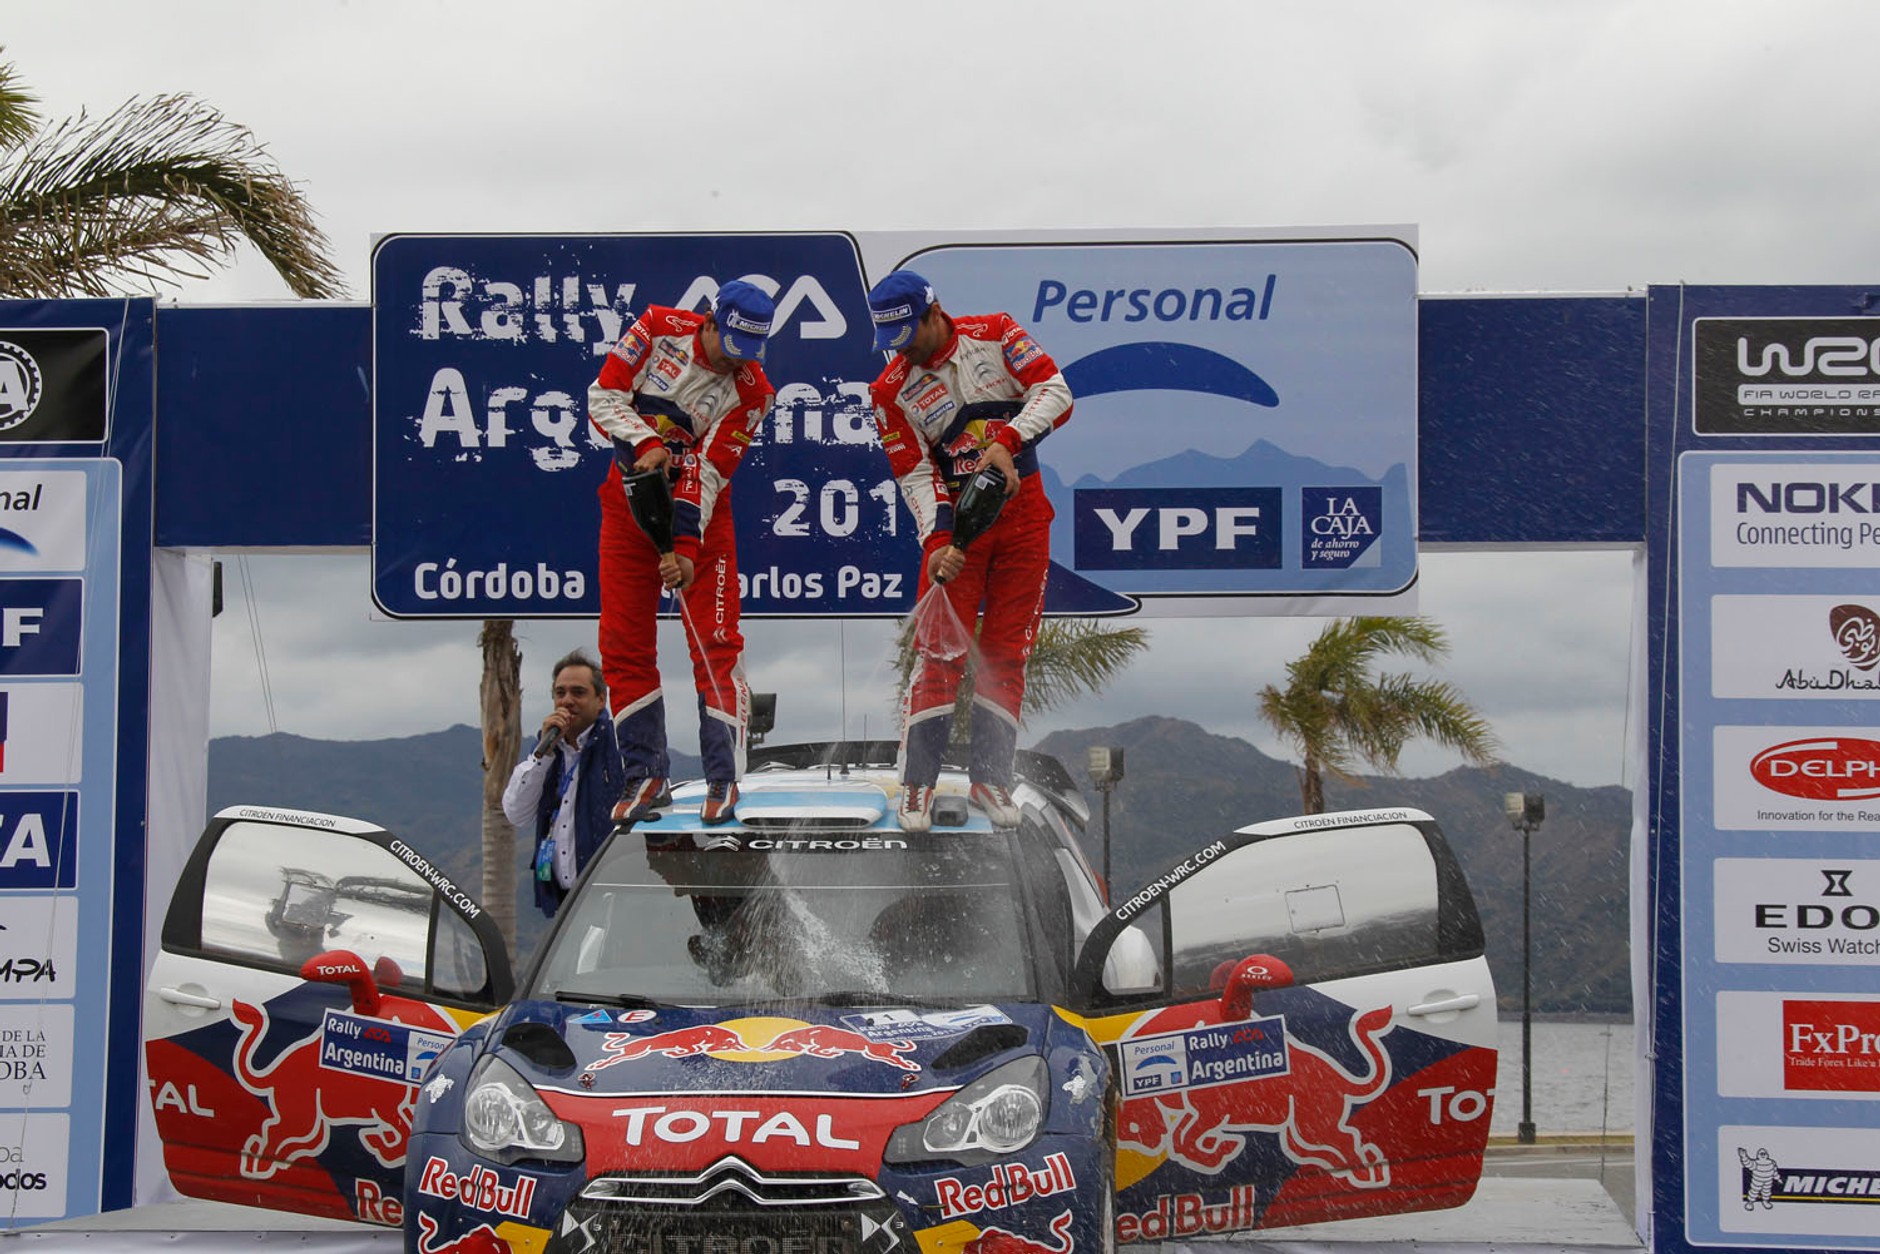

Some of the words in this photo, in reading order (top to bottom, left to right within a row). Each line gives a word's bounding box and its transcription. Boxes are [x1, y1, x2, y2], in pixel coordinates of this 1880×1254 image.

[1032, 274, 1276, 323] Personal
[421, 266, 637, 355] Rally
[1738, 336, 1880, 376] WR
[1744, 390, 1773, 399] FIA
[1780, 390, 1852, 400] WORLD
[773, 478, 897, 537] 201
[1326, 497, 1361, 516] LA
[1093, 507, 1260, 551] YPF
[1310, 516, 1374, 540] CAJA
[1736, 522, 1853, 549] Connecting
[1311, 538, 1323, 549] de
[1325, 537, 1360, 549] ahorro
[1311, 551, 1318, 561] y
[1319, 550, 1350, 561] seguro
[415, 557, 585, 599] Córdoba
[838, 565, 902, 598] Paz
[275, 813, 336, 828] FINANCIACION
[1337, 811, 1408, 824] FINANCIACION
[1757, 809, 1815, 821] Innovation
[1818, 809, 1833, 821] for
[1837, 810, 1854, 821] the
[749, 837, 907, 850] CITROËN
[1768, 936, 1822, 954] Swiss
[317, 964, 361, 976] TOTAL
[2, 1030, 22, 1042] DE
[27, 1030, 45, 1042] LA
[327, 1017, 362, 1040] Rally
[23, 1044, 46, 1058] DE
[417, 1037, 446, 1050] Person
[1134, 1040, 1175, 1056] Personal
[1189, 1032, 1228, 1051] Rally
[324, 1041, 404, 1076] Argentina
[1191, 1051, 1284, 1080] Argentina
[1791, 1057, 1815, 1067] Trade
[1136, 1076, 1160, 1088] YPF
[612, 1106, 860, 1151] TOTAL
[356, 1178, 404, 1226] Re
[1117, 1193, 1170, 1242] ed
